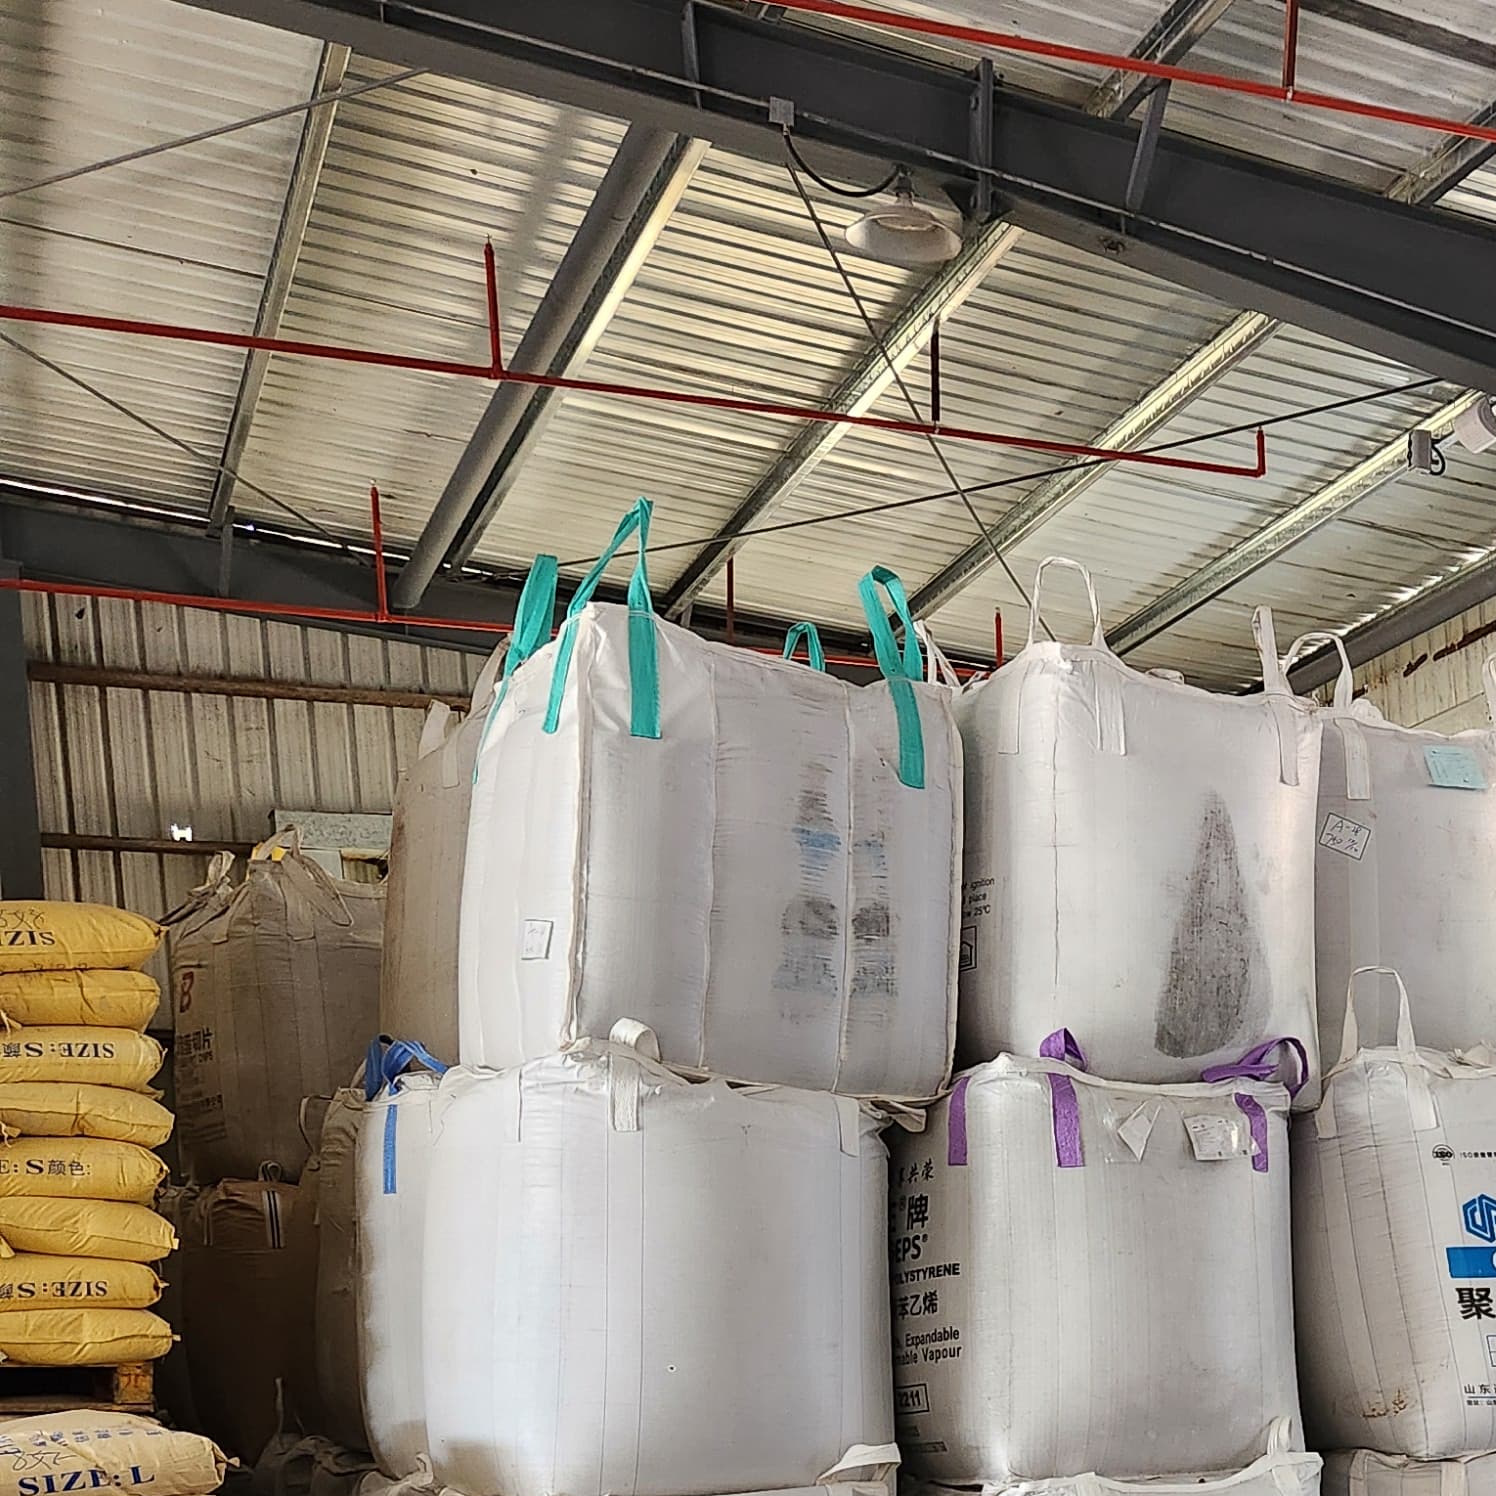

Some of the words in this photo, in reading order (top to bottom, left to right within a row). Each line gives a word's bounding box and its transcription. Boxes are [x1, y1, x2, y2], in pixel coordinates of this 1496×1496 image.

[0, 930, 56, 946] SIZ
[905, 1325, 960, 1350] Expandable
[921, 1346, 962, 1364] Vapour
